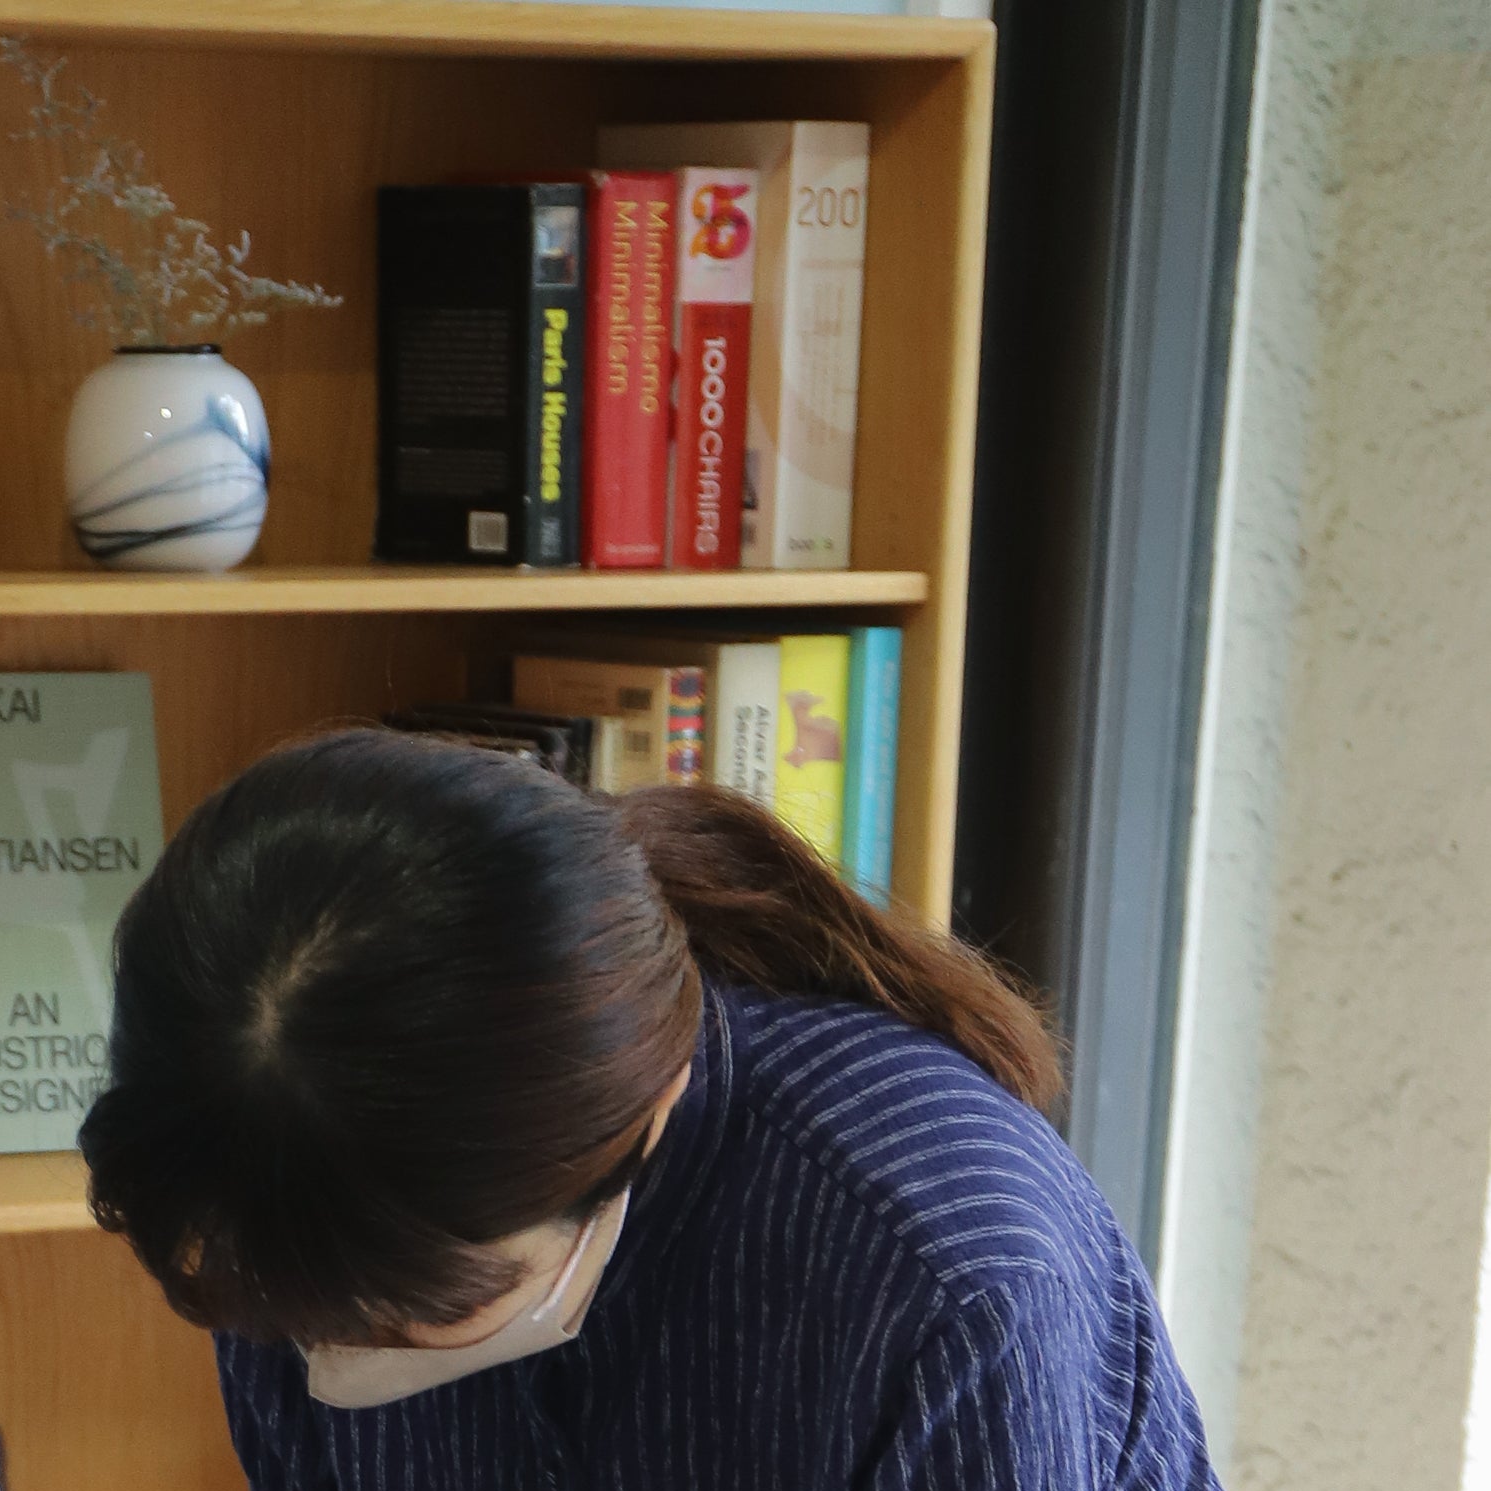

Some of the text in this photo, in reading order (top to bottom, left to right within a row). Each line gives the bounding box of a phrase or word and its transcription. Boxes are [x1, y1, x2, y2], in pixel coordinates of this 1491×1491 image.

[797, 186, 860, 227] 200
[609, 201, 638, 394] Minimalism
[640, 201, 670, 416] Minimalismo
[543, 308, 569, 386] Paris
[700, 336, 727, 428] 1000
[540, 392, 567, 502] Houses
[10, 993, 61, 1027] AN
